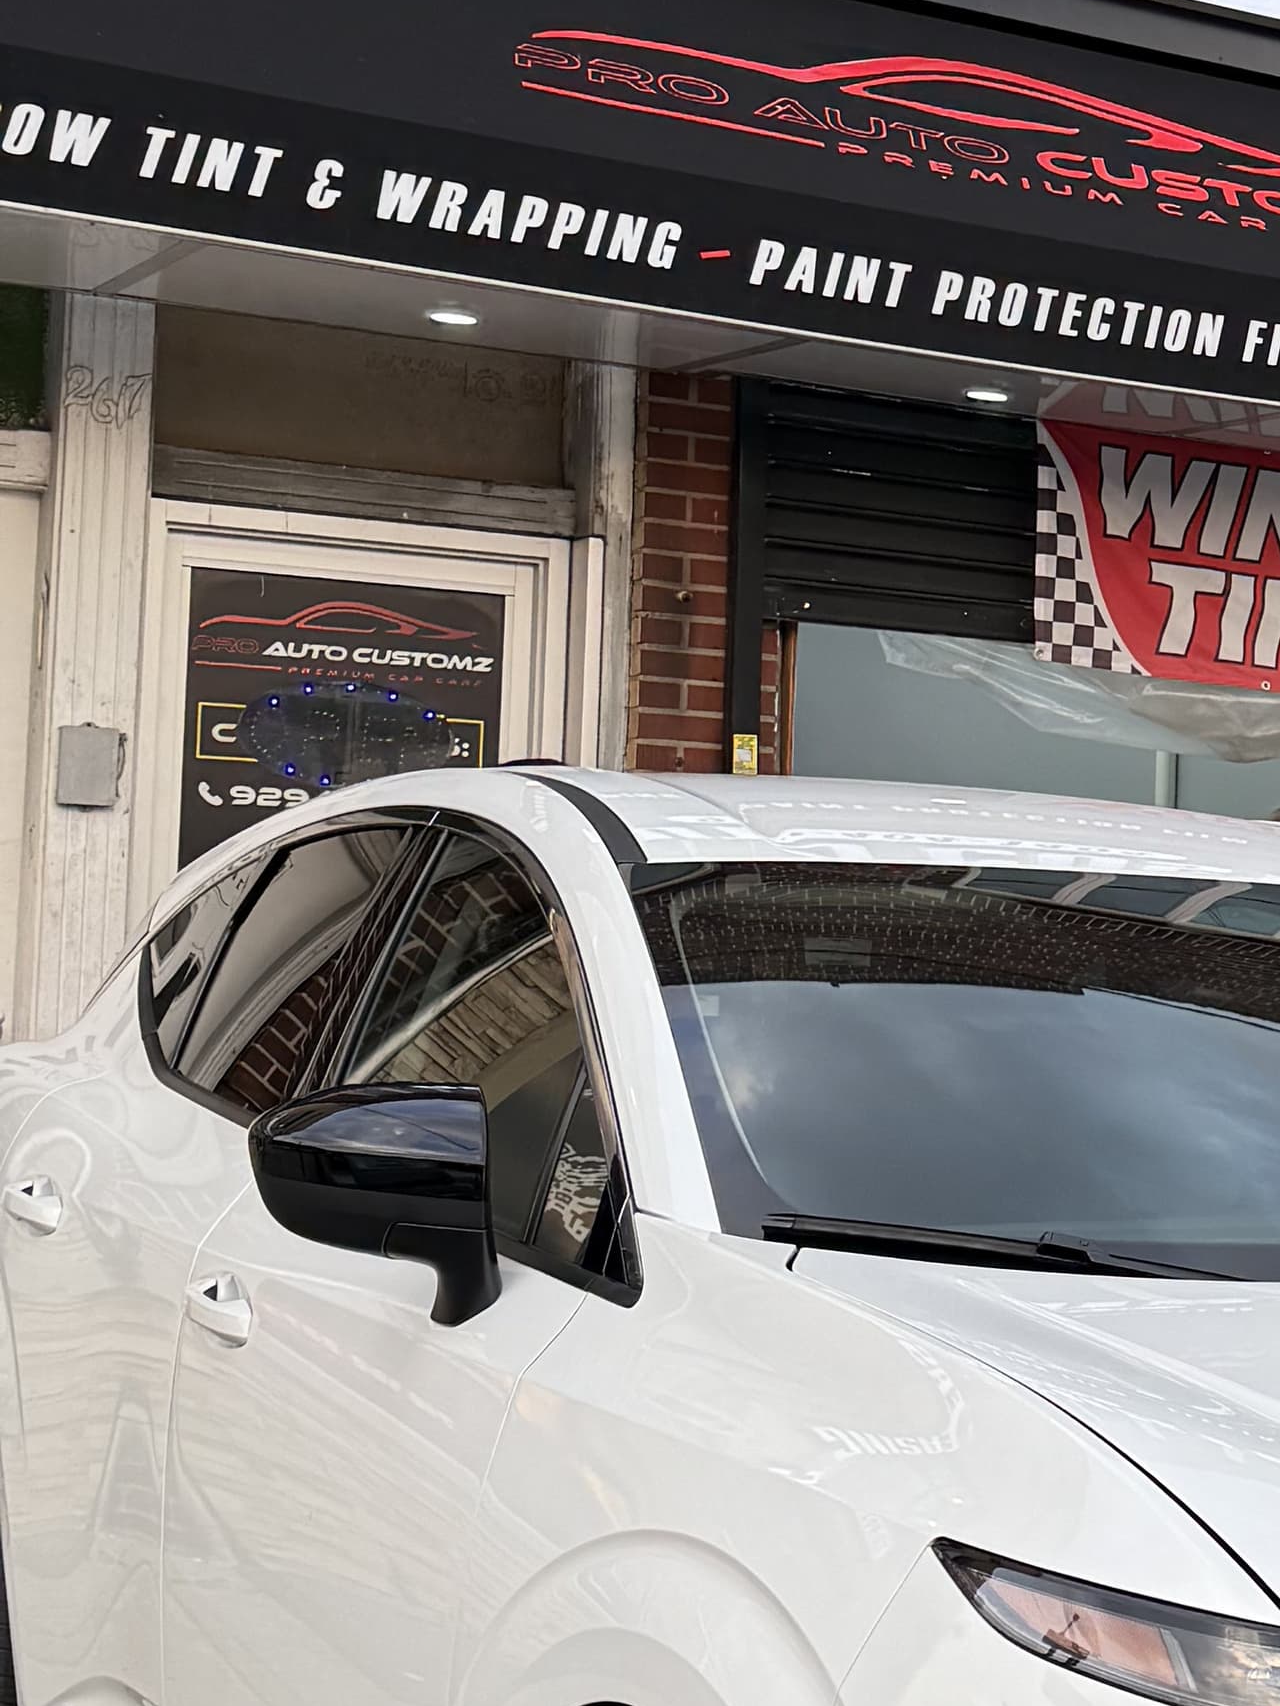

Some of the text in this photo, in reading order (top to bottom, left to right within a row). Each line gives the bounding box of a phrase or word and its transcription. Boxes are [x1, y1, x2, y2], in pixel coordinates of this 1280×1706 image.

[515, 44, 729, 105] PRO
[754, 97, 1009, 163] AUTO
[0, 102, 111, 166] OW
[138, 126, 283, 198] TINT
[306, 158, 344, 209] &
[376, 169, 683, 269] WRAPPING
[749, 239, 912, 308] PAINT
[931, 270, 1225, 358] PROTECTION
[838, 142, 1123, 205] PREMIUM
[1156, 202, 1268, 231] CAR
[191, 634, 494, 673] PRO AUTO CUSTOMZ
